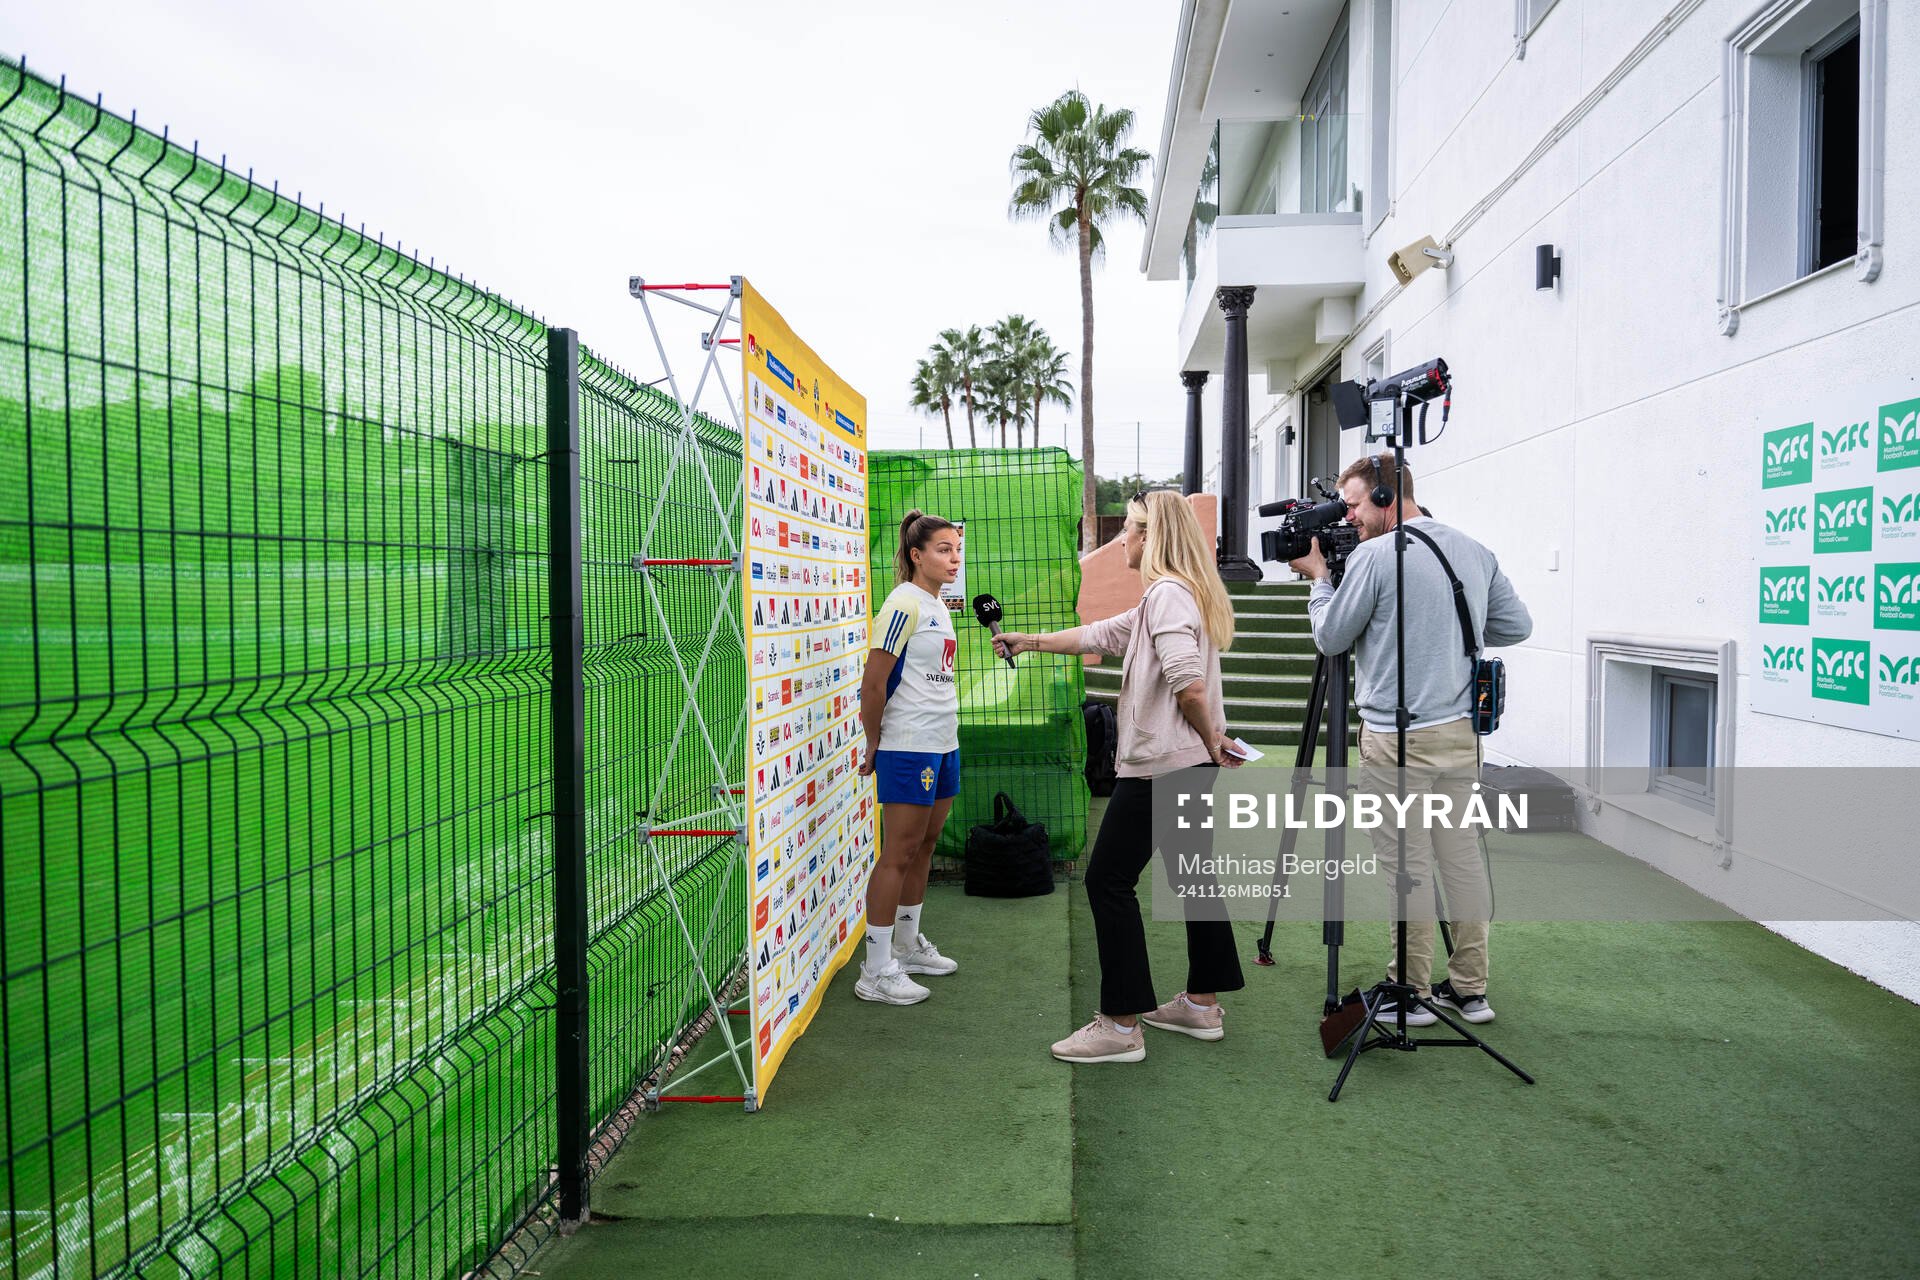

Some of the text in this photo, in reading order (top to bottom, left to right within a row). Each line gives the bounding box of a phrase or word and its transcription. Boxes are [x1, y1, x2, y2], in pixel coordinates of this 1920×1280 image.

[1401, 373, 1427, 387] Aputure
[1884, 450, 1902, 460] Football
[752, 517, 762, 538] ICA
[983, 600, 999, 611] svt
